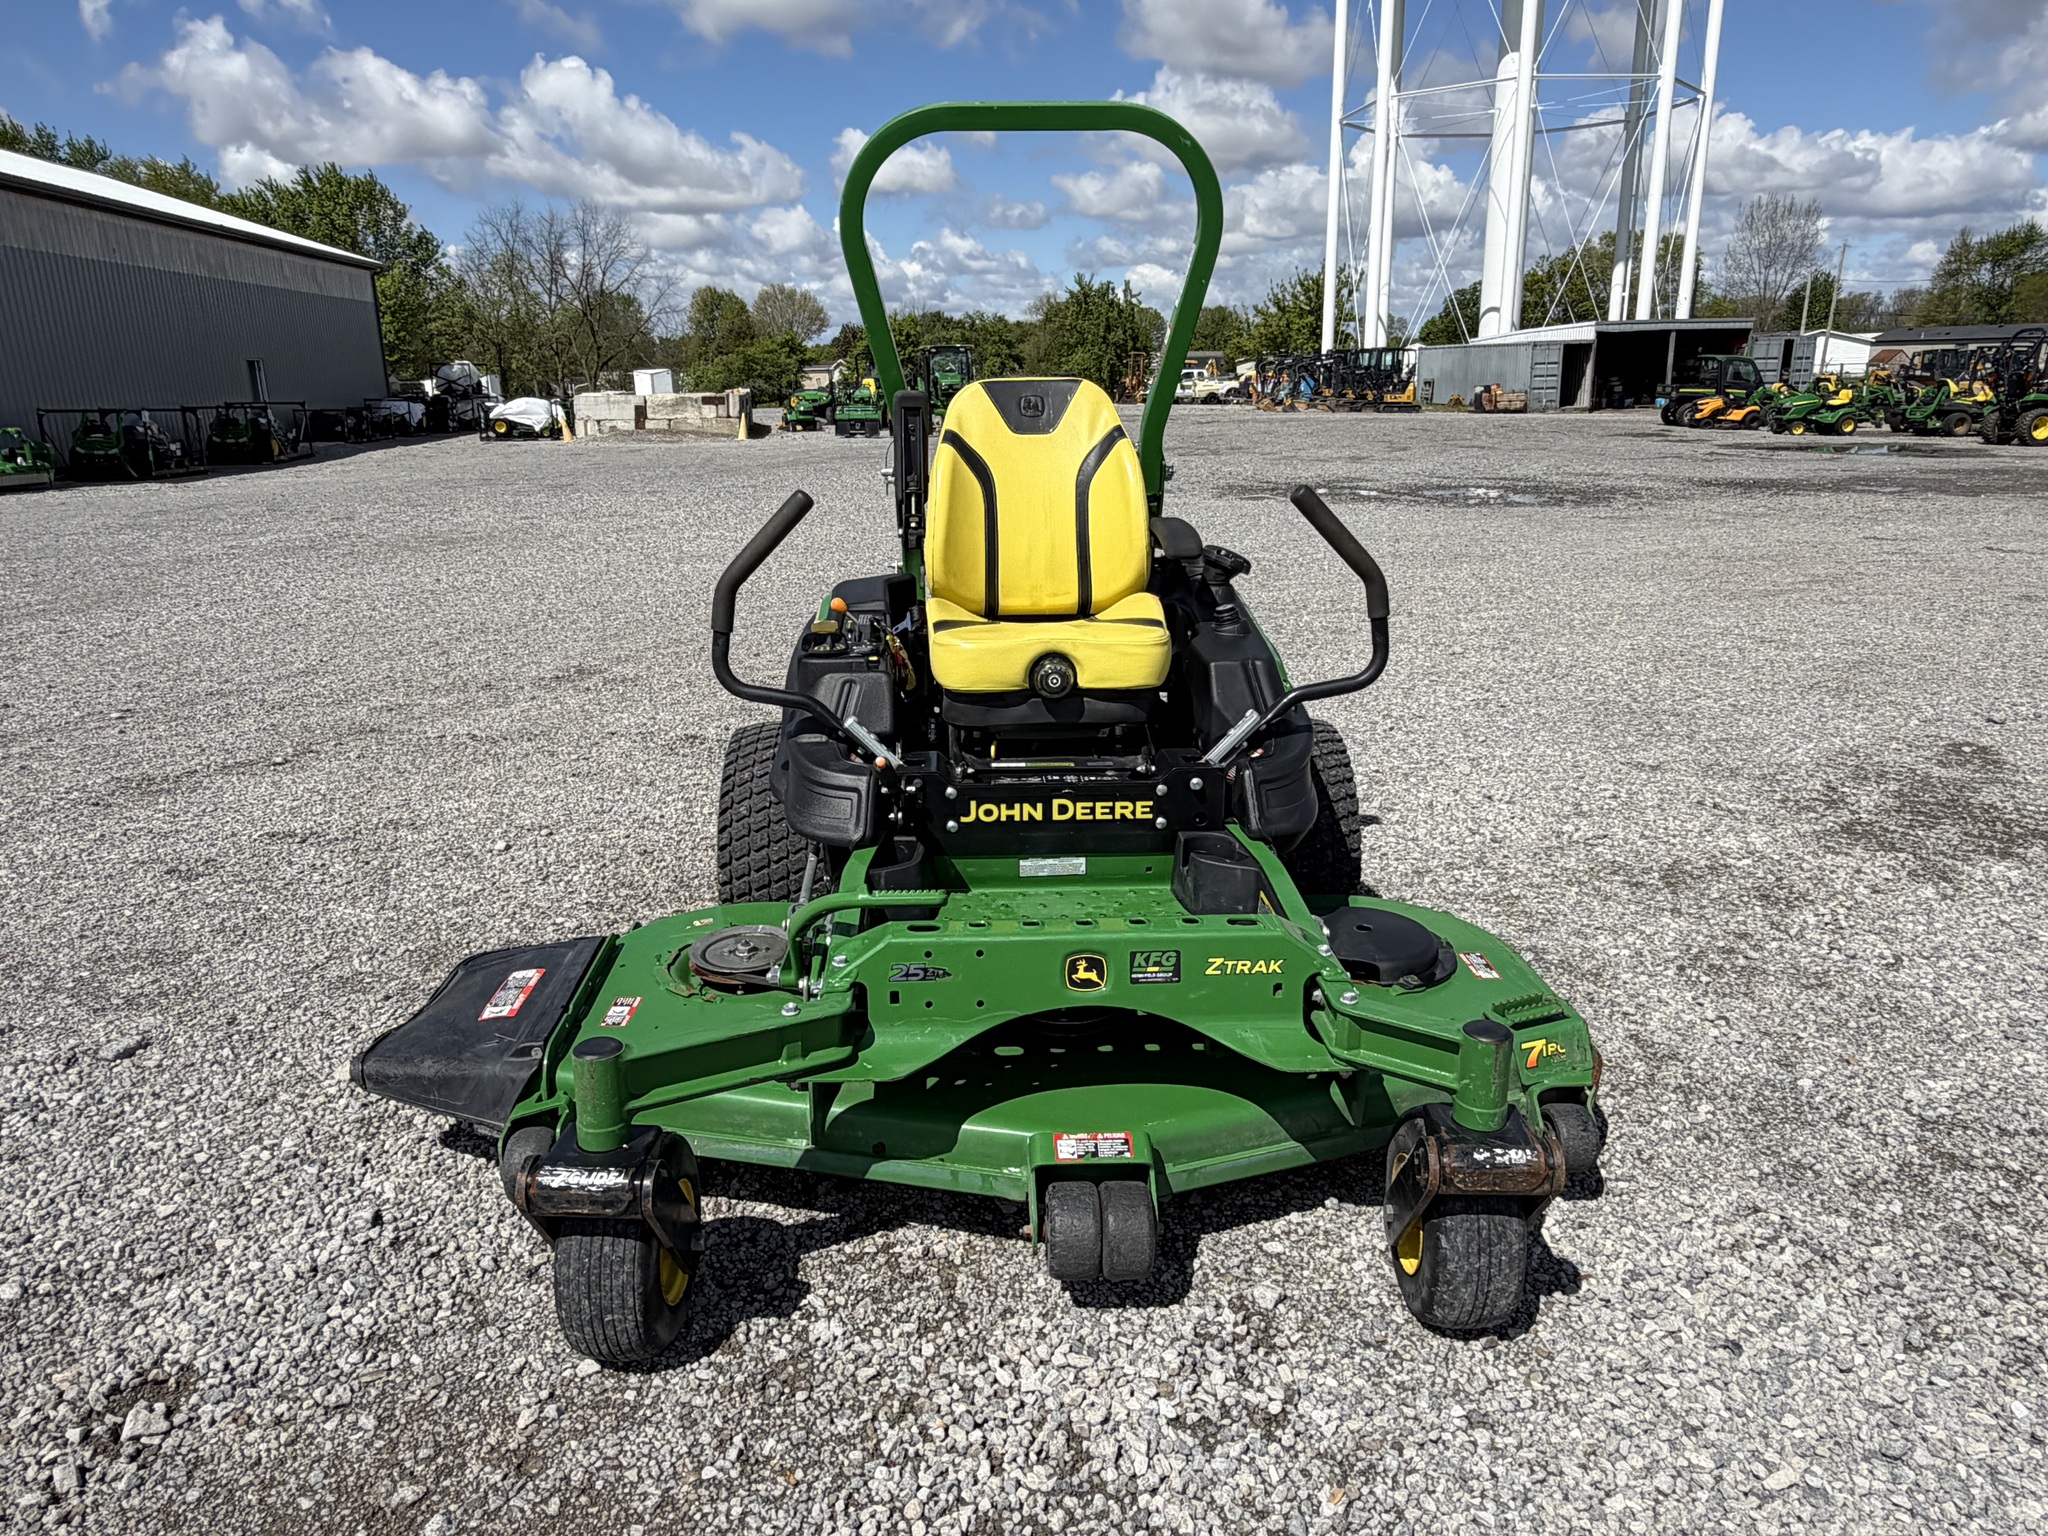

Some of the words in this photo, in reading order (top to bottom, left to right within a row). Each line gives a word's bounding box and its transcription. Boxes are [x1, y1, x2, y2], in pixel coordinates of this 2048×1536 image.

[960, 800, 1043, 822] JOHN
[1052, 799, 1154, 820] DEERE
[1133, 951, 1177, 967] KFG
[1205, 957, 1284, 975] ZTRAK
[889, 963, 926, 982] 25
